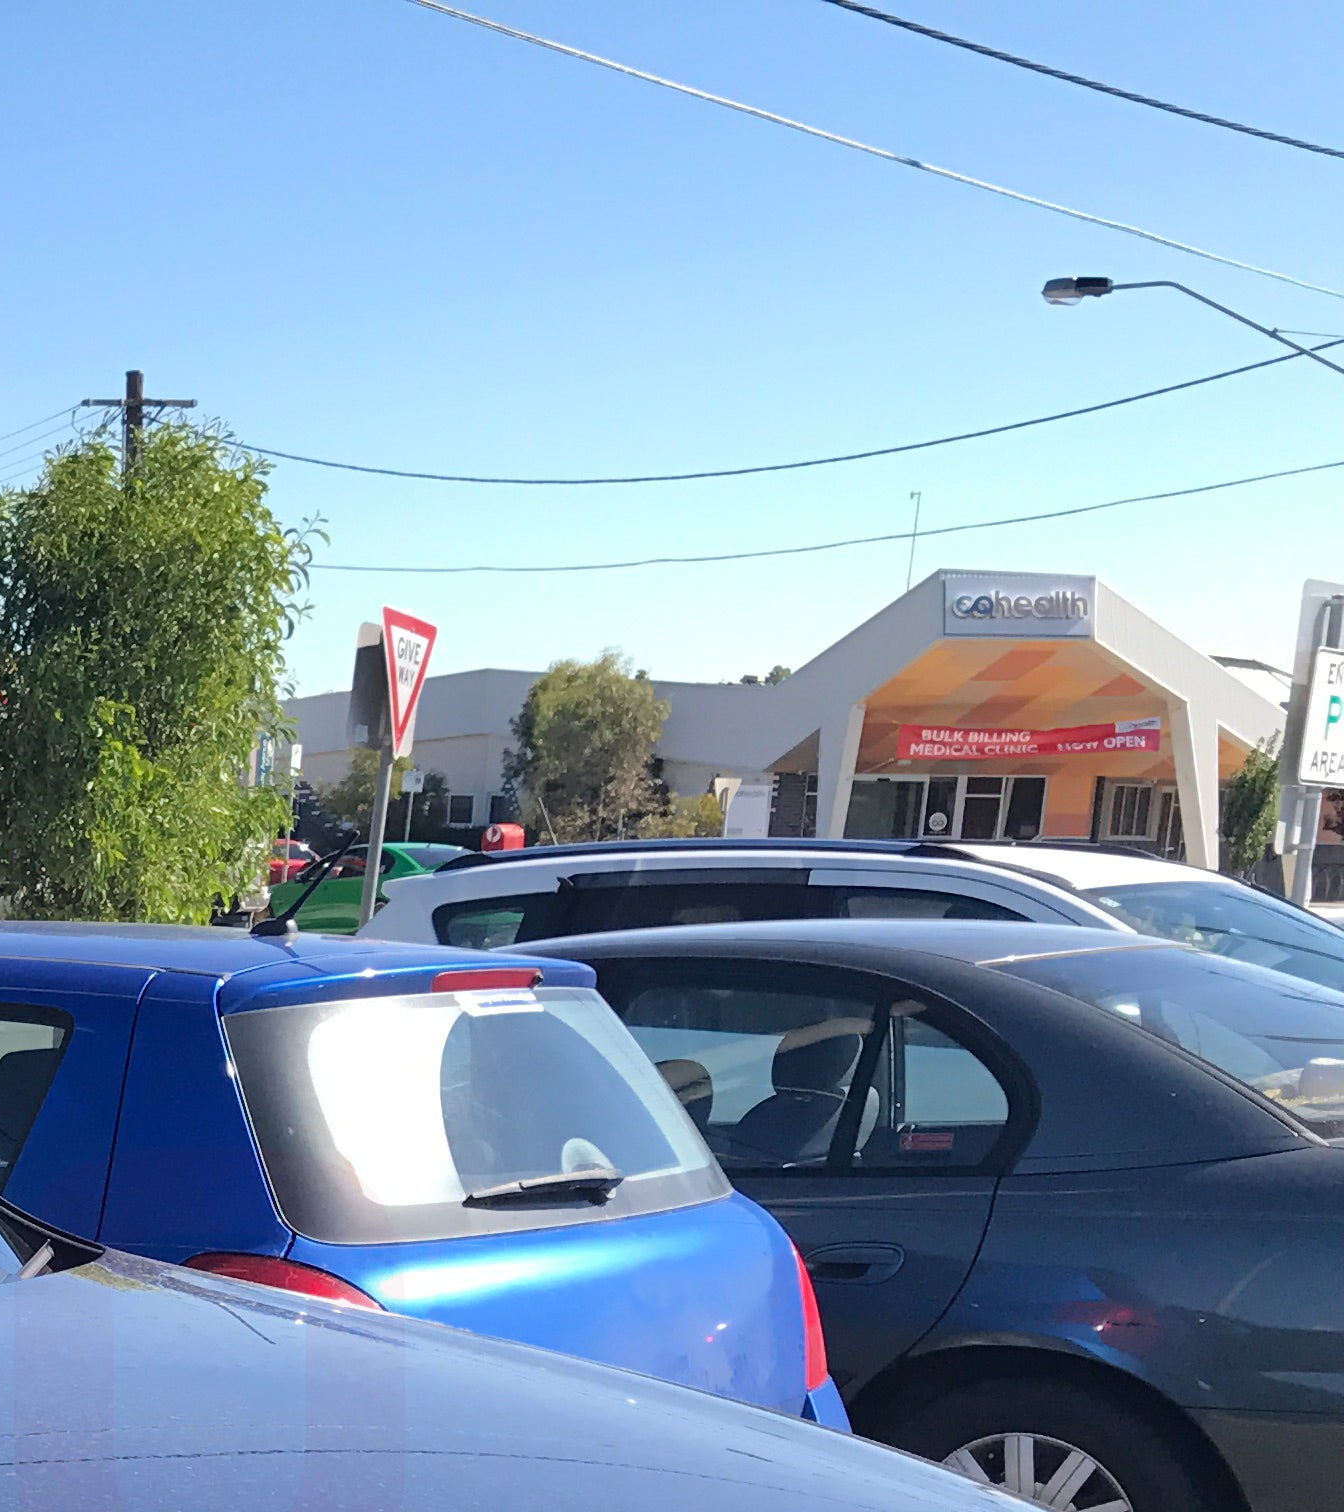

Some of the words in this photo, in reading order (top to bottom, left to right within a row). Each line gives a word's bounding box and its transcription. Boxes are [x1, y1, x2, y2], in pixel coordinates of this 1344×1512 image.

[953, 590, 1088, 619] cohealth
[397, 637, 422, 666] GIVE
[398, 666, 416, 688] WAY
[1324, 695, 1343, 741] P
[921, 729, 964, 743] BULK
[967, 730, 1031, 743] BILLING
[1103, 735, 1147, 749] OPEN
[910, 743, 981, 756] MEDICAL
[983, 744, 1038, 755] CLINIC
